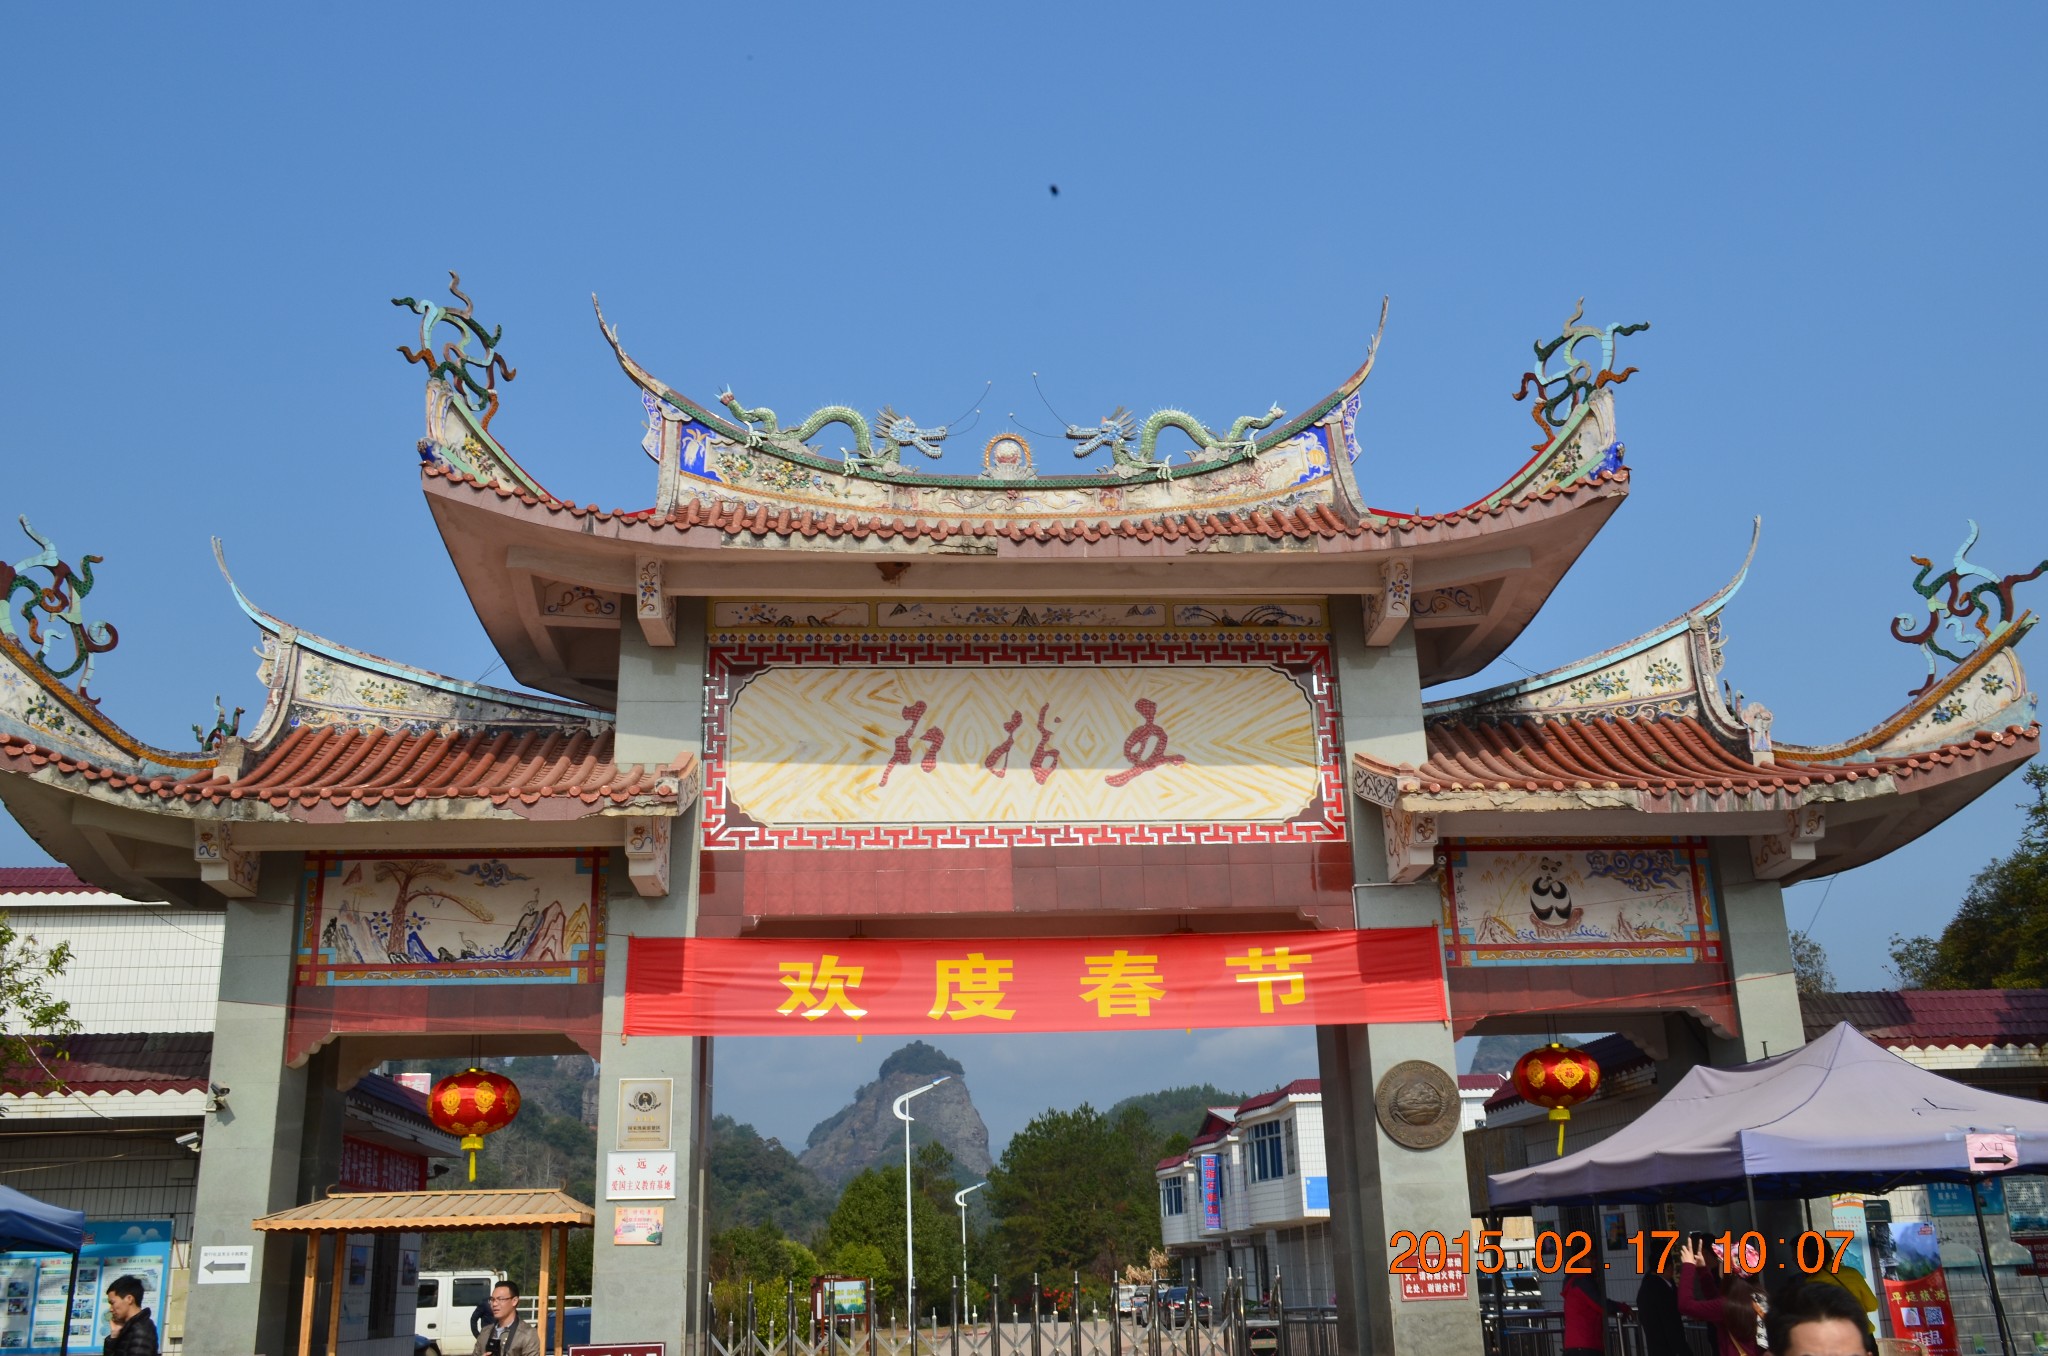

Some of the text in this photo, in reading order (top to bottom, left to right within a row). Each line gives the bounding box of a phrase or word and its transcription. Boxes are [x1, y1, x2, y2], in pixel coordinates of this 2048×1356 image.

[775, 946, 1313, 1022] 欢度春节
[1979, 1142, 2004, 1152] 入口
[617, 1158, 668, 1176] 平远县
[611, 1180, 671, 1191] 爱国主义教育基地
[1890, 1288, 1947, 1305] 平远旅游
